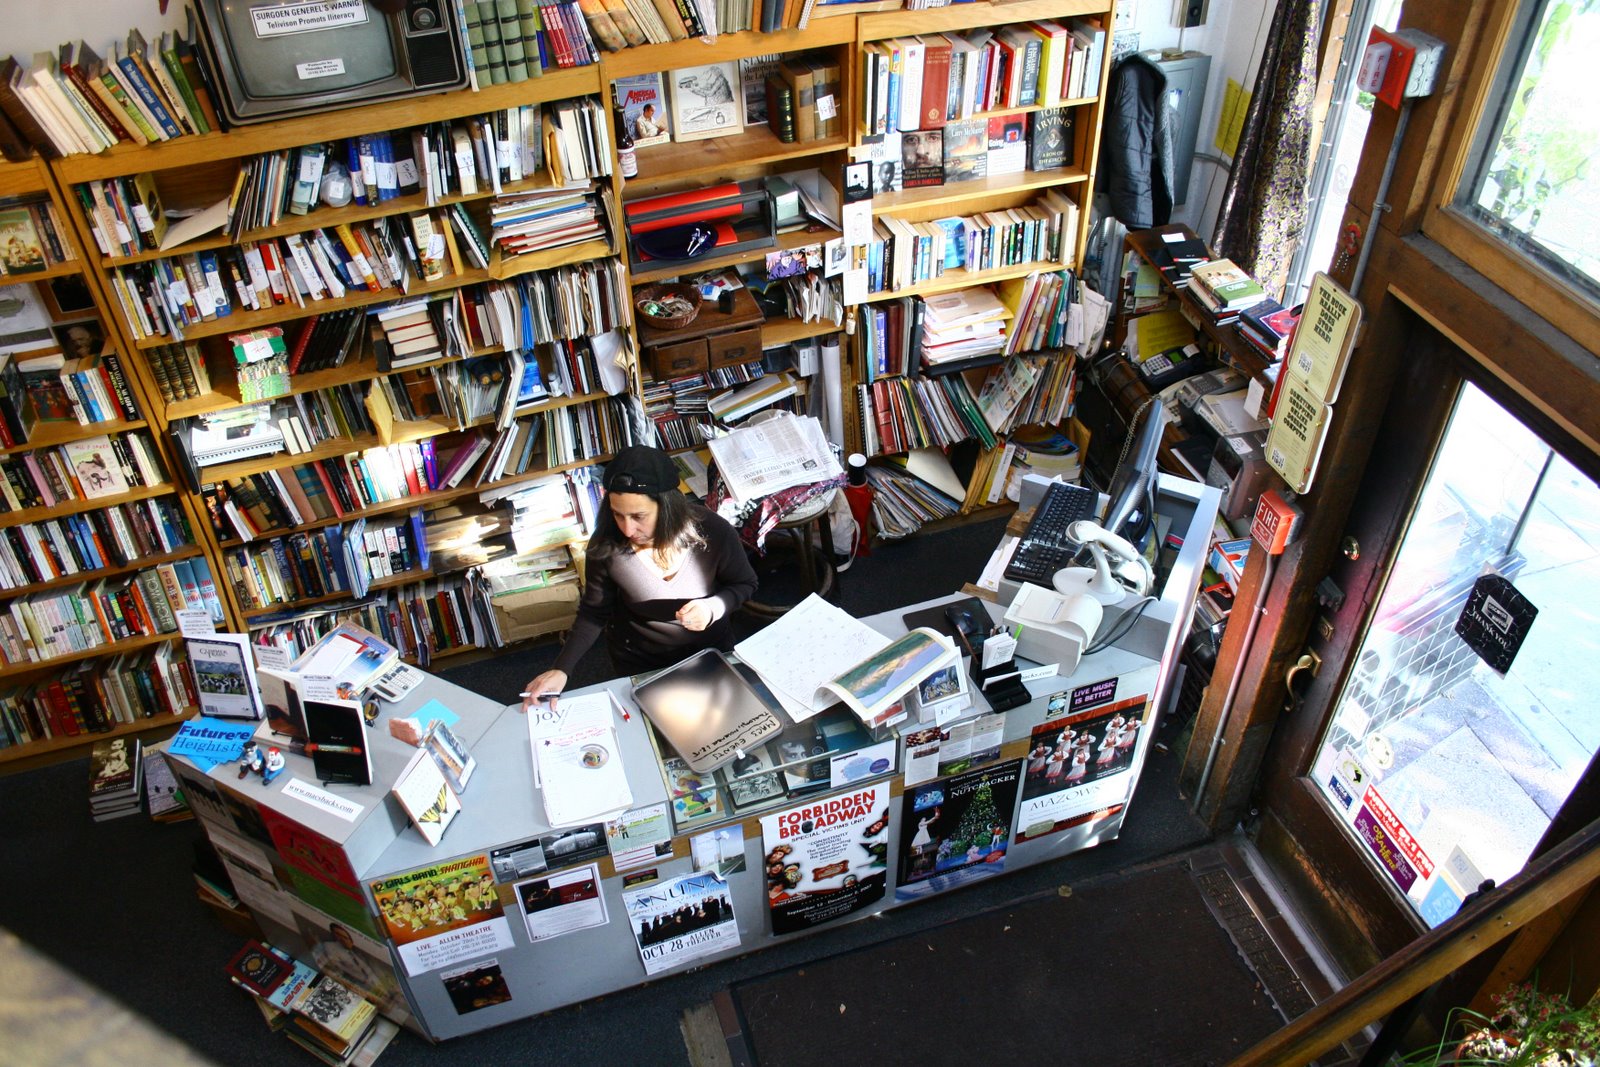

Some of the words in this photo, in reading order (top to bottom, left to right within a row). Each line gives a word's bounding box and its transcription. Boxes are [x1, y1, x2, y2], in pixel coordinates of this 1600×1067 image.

[256, 9, 290, 20] SURGOEN
[292, 4, 329, 16] GENEREL'S
[267, 21, 297, 29] Telivison
[299, 16, 326, 26] Promots
[1370, 55, 1385, 87] FIRE
[1036, 117, 1072, 131] IRVING
[1319, 298, 1342, 321] REALLY
[1320, 309, 1336, 327] DOES
[1313, 324, 1331, 344] HERE!
[1317, 316, 1333, 333] STOP
[1289, 388, 1317, 416] SOMETIMES
[1289, 396, 1313, 422] SHOPPING
[1271, 455, 1284, 469] FIRST
[1257, 502, 1279, 533] FIRE
[1073, 688, 1090, 698] LIVE
[1092, 680, 1116, 693] MUSIC
[1075, 697, 1083, 705] IS
[1084, 689, 1112, 702] BETTER
[536, 708, 565, 726] joy
[179, 726, 235, 740] Future
[712, 738, 747, 760] EVENTS
[950, 774, 1016, 799] NUTCRACKER
[288, 784, 354, 814] www.macsbacks.com
[778, 789, 876, 828] FORBIDDEN
[779, 801, 875, 839] BROADWAY
[791, 831, 820, 843] SPECIAL
[822, 823, 849, 835] VICTIMS
[850, 817, 865, 825] UNIT
[1367, 787, 1399, 828] WRUW
[1398, 827, 1418, 854] 91.1
[1416, 850, 1434, 874] FM
[1373, 824, 1385, 840] ON
[1376, 837, 1392, 856] SALE
[1381, 850, 1398, 872] HERE
[374, 883, 385, 893] 12
[385, 875, 412, 890] GIRLS
[412, 869, 438, 880] BAND
[439, 856, 485, 875] SHANGHAI
[786, 905, 815, 916] September
[827, 893, 853, 904] December
[439, 934, 461, 945] ALLEN
[461, 926, 492, 939] THEATRE
[685, 931, 721, 947] THEATER
[689, 928, 715, 940] ALLEN
[440, 942, 462, 951] October
[642, 945, 668, 960] OCT.
[670, 939, 684, 953] 28
[282, 979, 305, 1007] NEVER
